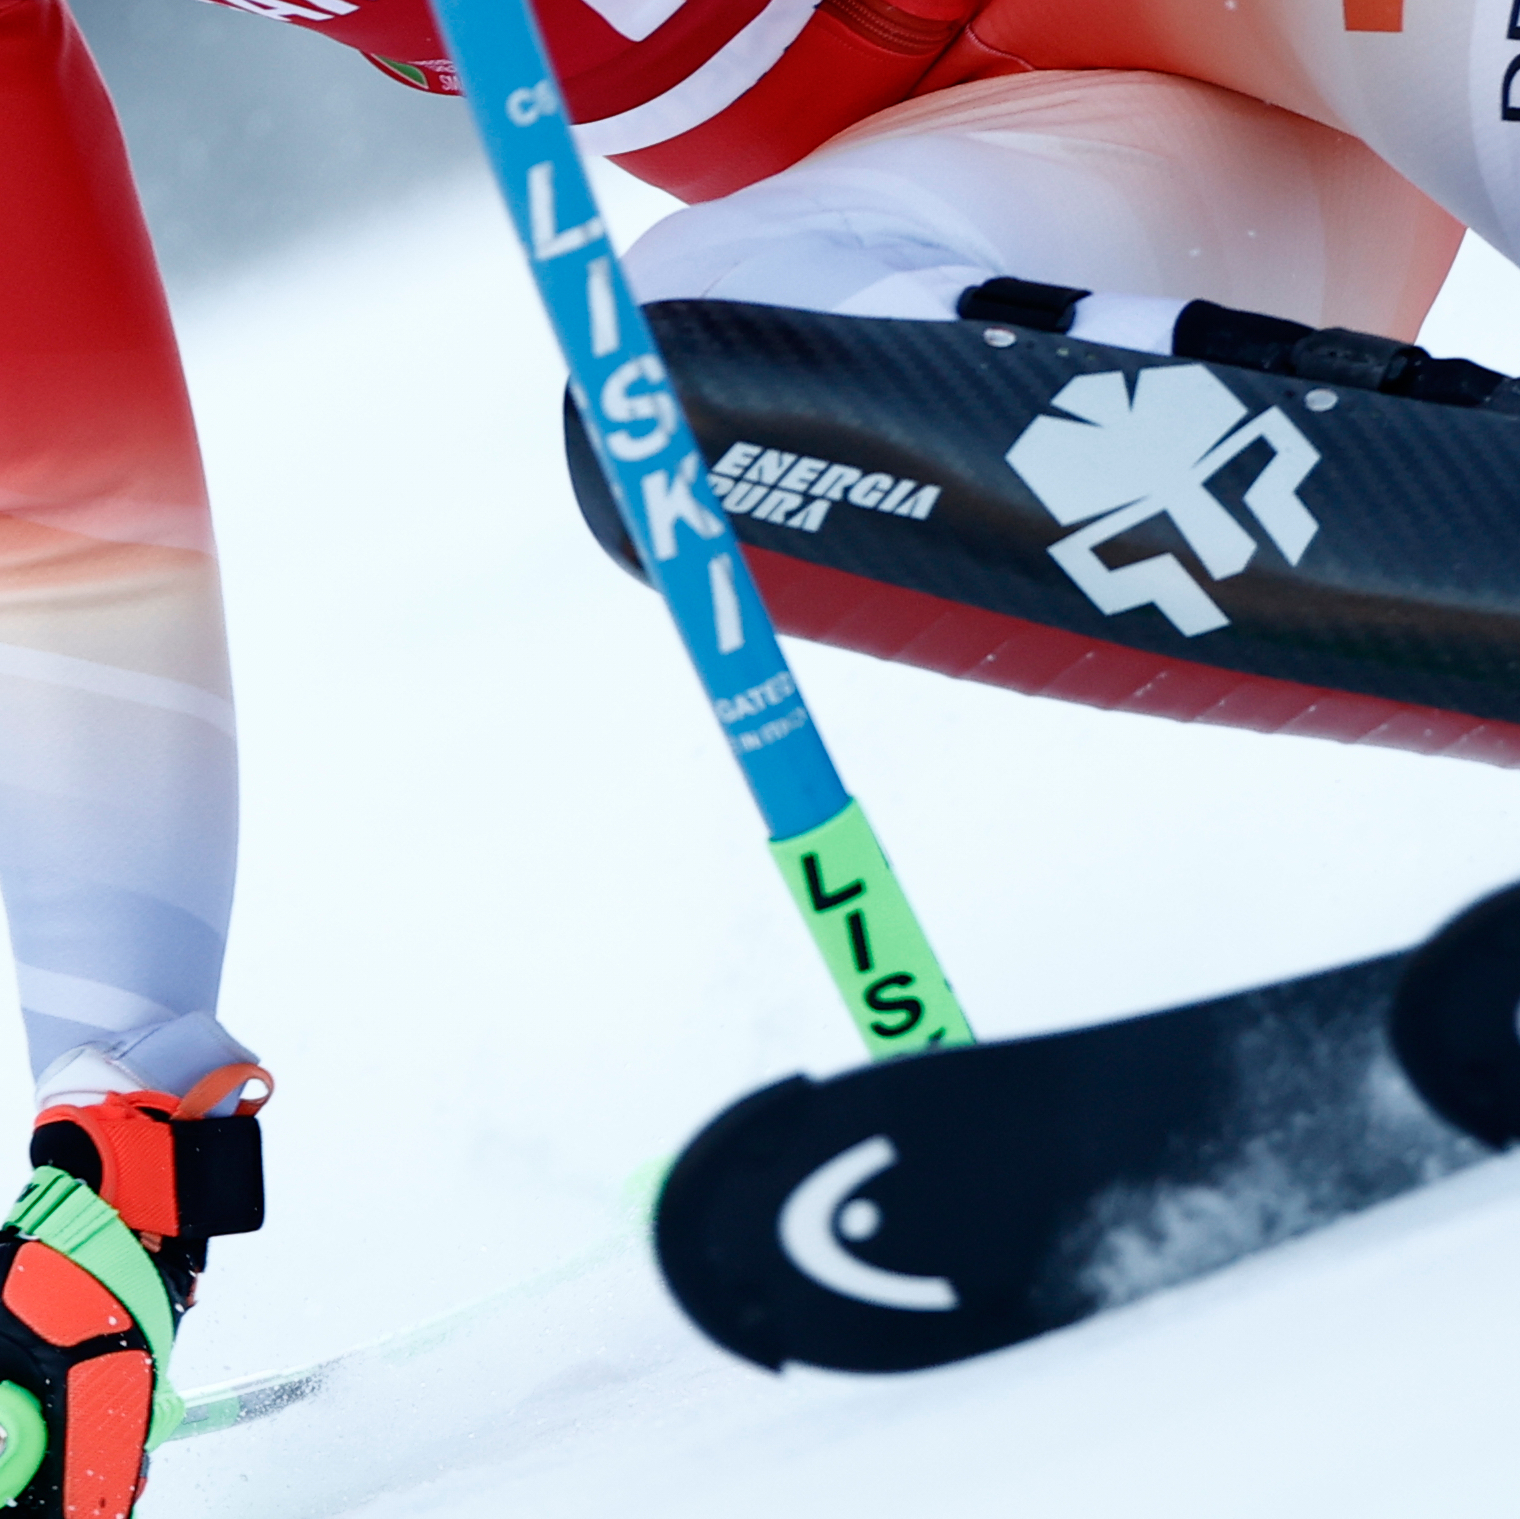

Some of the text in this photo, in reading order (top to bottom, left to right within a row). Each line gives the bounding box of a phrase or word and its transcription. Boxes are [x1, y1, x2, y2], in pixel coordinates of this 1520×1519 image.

[526, 160, 746, 655] LISKI
[712, 440, 943, 521] ENERGIA
[801, 851, 947, 1048] LIS
